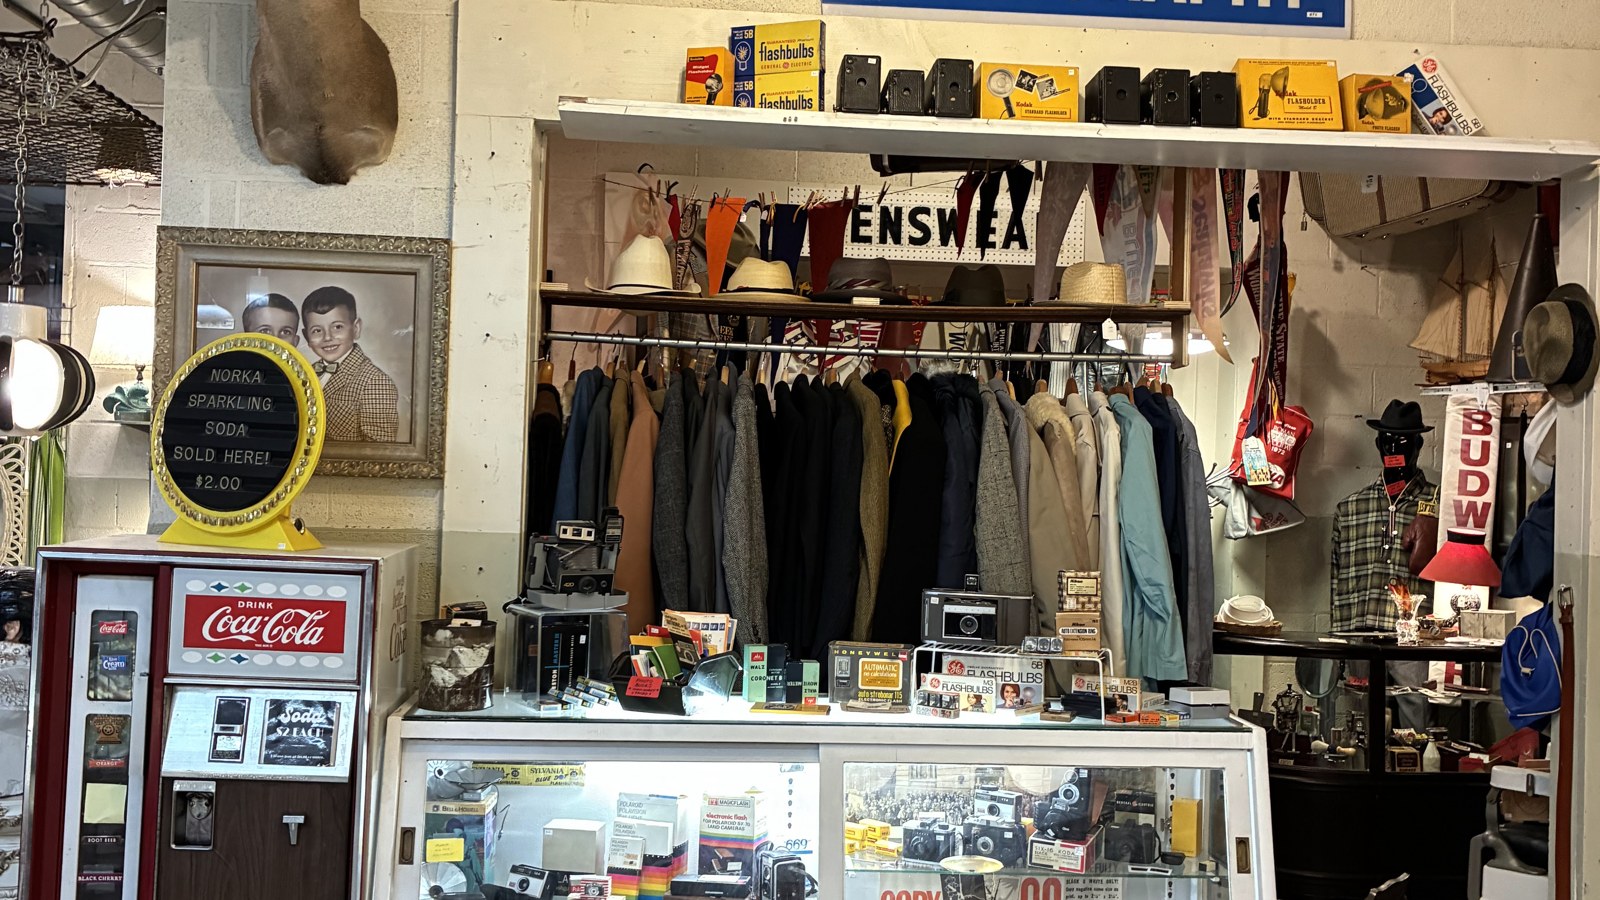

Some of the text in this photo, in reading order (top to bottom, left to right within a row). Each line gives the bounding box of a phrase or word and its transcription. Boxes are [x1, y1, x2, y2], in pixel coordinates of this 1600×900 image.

[744, 30, 754, 40] 5B
[759, 42, 814, 62] flashbulbs
[744, 81, 754, 90] 5B
[758, 93, 813, 110] flashbulbs
[1428, 74, 1473, 136] FLASHBULBS
[850, 205, 1029, 251] ENSWEA
[210, 368, 262, 384] NORKA
[188, 394, 272, 411] SPARKLING
[204, 421, 246, 436] SODA
[174, 446, 270, 465] SOLD HERE!
[1453, 407, 1493, 529] BUDW
[196, 474, 240, 490] $2.00
[237, 601, 273, 610] DRINK
[202, 605, 330, 646] Coca-Cola
[102, 659, 125, 670] Cream
[1031, 661, 1043, 669] 5B
[967, 669, 1043, 684] FLASHBULBS
[858, 690, 869, 698] auto
[942, 683, 994, 694] FLASHBULBS
[1086, 683, 1138, 694] FLAHBULBS
[279, 706, 327, 724] Soda
[706, 812, 733, 820] electronic
[786, 840, 808, 850] 669
